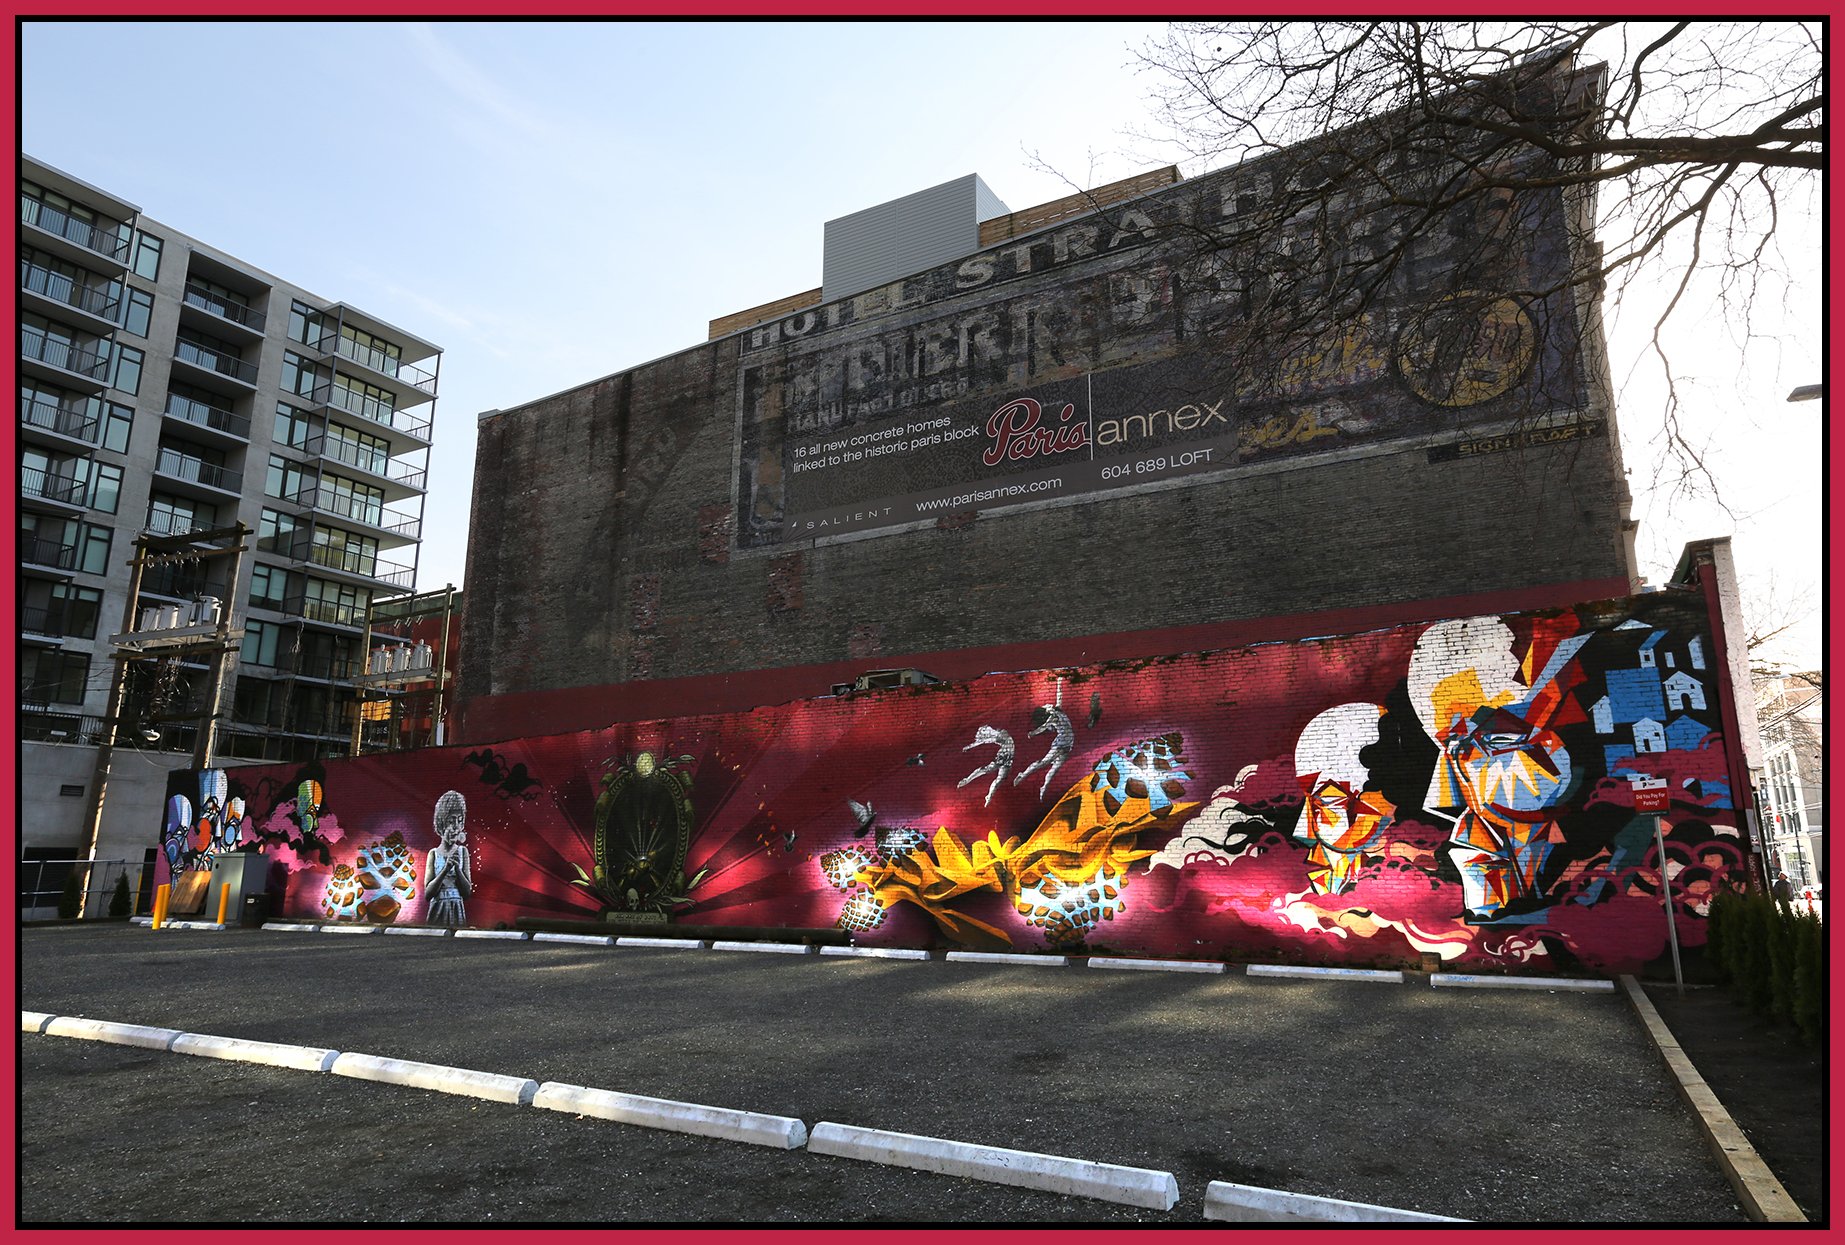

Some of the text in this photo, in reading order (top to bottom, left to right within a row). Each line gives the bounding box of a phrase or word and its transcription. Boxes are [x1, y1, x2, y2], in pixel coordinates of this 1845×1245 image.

[793, 416, 951, 459] 16 all new concrete homes
[982, 397, 1092, 466] Paris
[1097, 400, 1228, 446] annex
[793, 424, 980, 473] linked to the historic paris block
[1101, 448, 1214, 480] 604 689 LOFT
[915, 476, 1063, 512] www.parisannex.com
[806, 507, 892, 530] SALIENT
